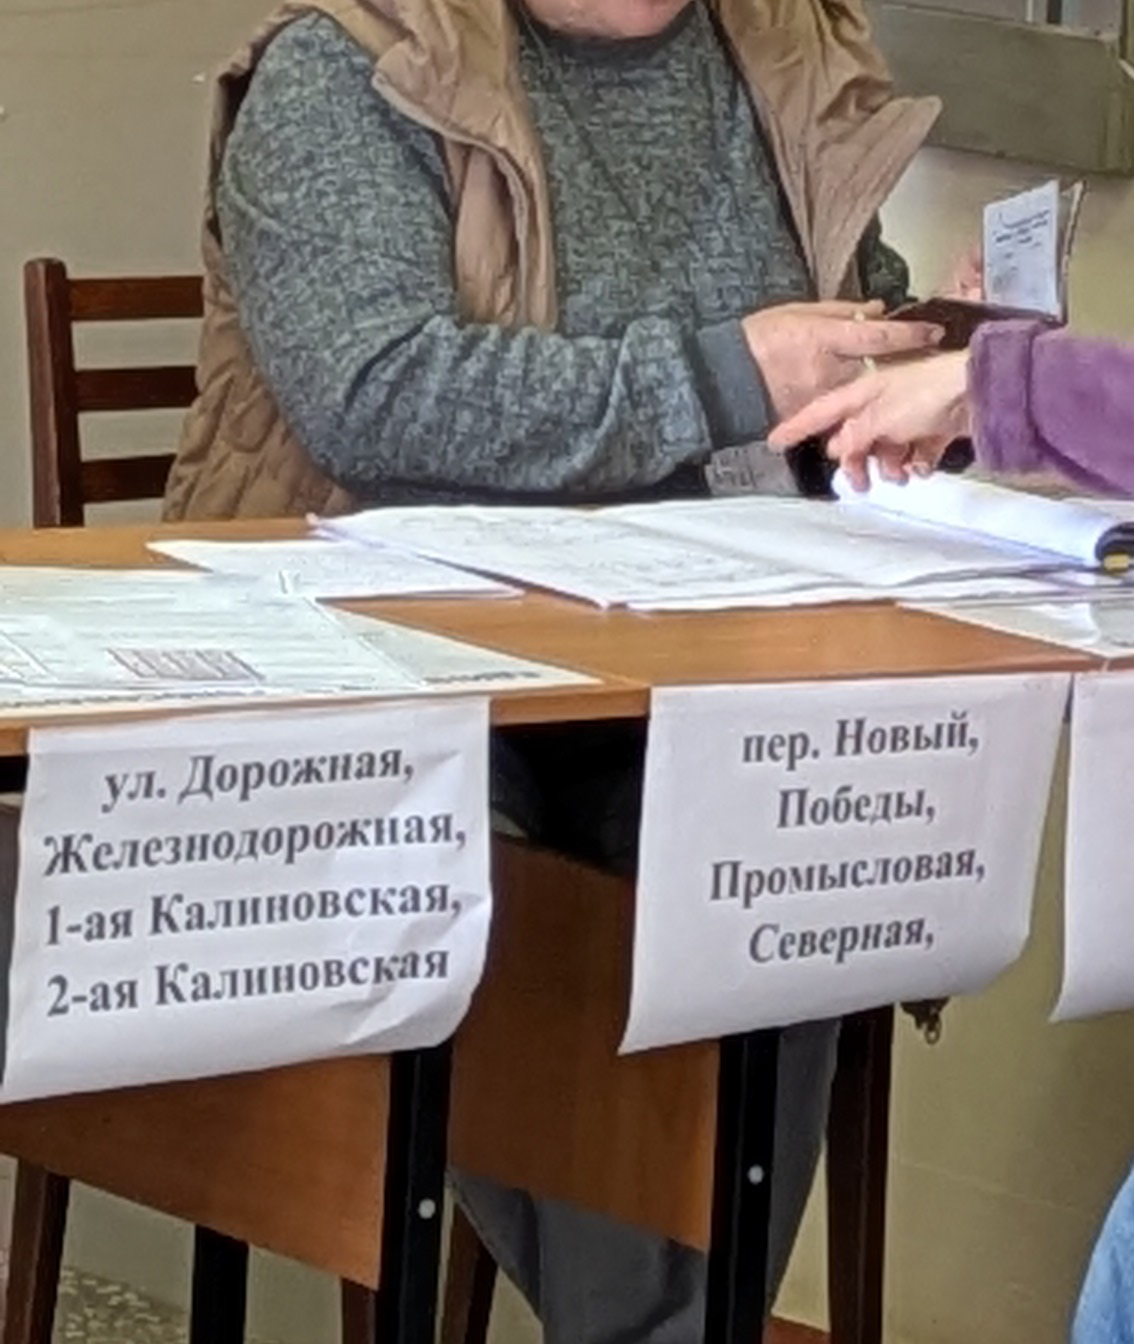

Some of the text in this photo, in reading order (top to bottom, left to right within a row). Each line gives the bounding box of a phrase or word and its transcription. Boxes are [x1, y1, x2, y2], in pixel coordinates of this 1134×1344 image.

[742, 710, 979, 772] пер. Новый,
[102, 749, 415, 813] ул. Дорожная,
[777, 784, 935, 829] Победы,
[43, 812, 467, 877] Железнодорожная,
[710, 848, 985, 910] Промысловая,
[46, 883, 463, 946] 1-ая Калиновская,
[748, 917, 934, 964] Северная,
[47, 949, 449, 1018] 2-ая Калиновская
